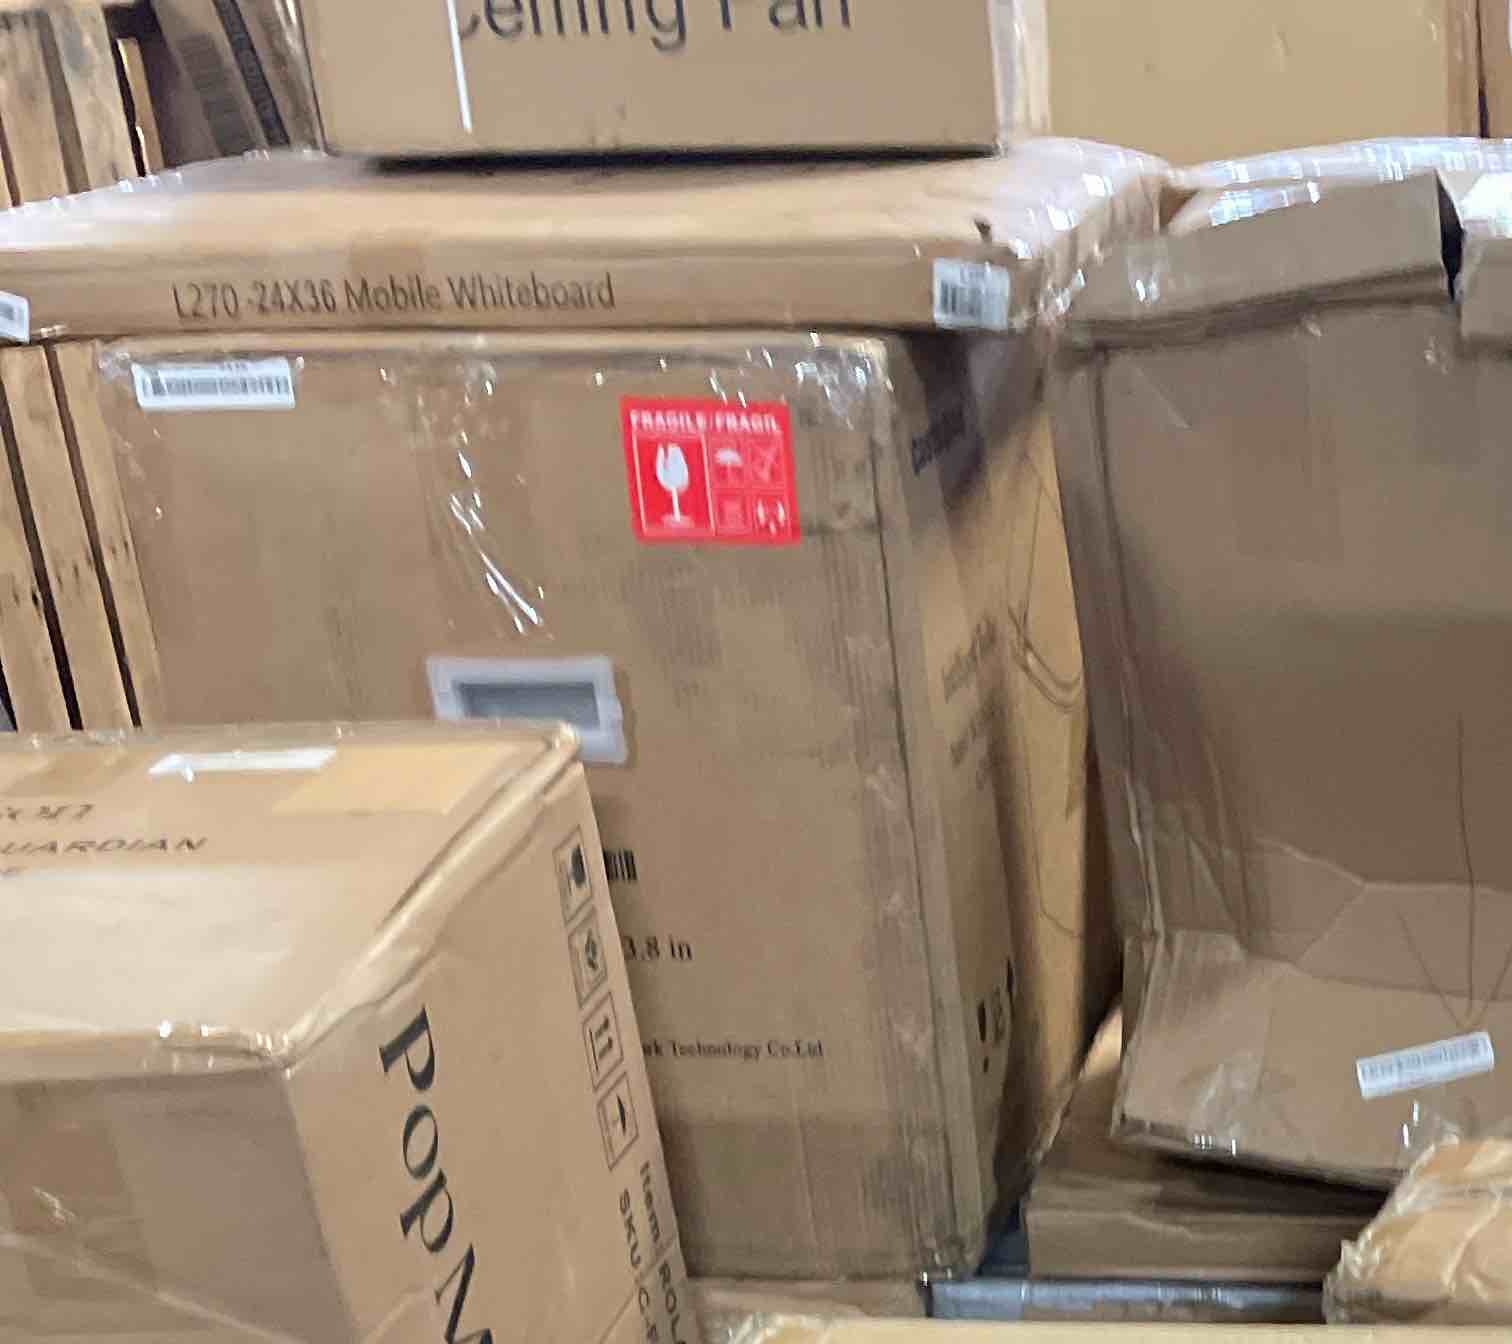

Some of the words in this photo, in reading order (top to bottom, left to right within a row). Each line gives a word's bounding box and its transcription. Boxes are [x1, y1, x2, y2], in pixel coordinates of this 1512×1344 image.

[460, 0, 686, 51] eiling
[343, 274, 440, 314] Mobile
[448, 270, 616, 312] Whiteboard
[668, 934, 693, 961] in
[379, 1003, 454, 1253] Pop
